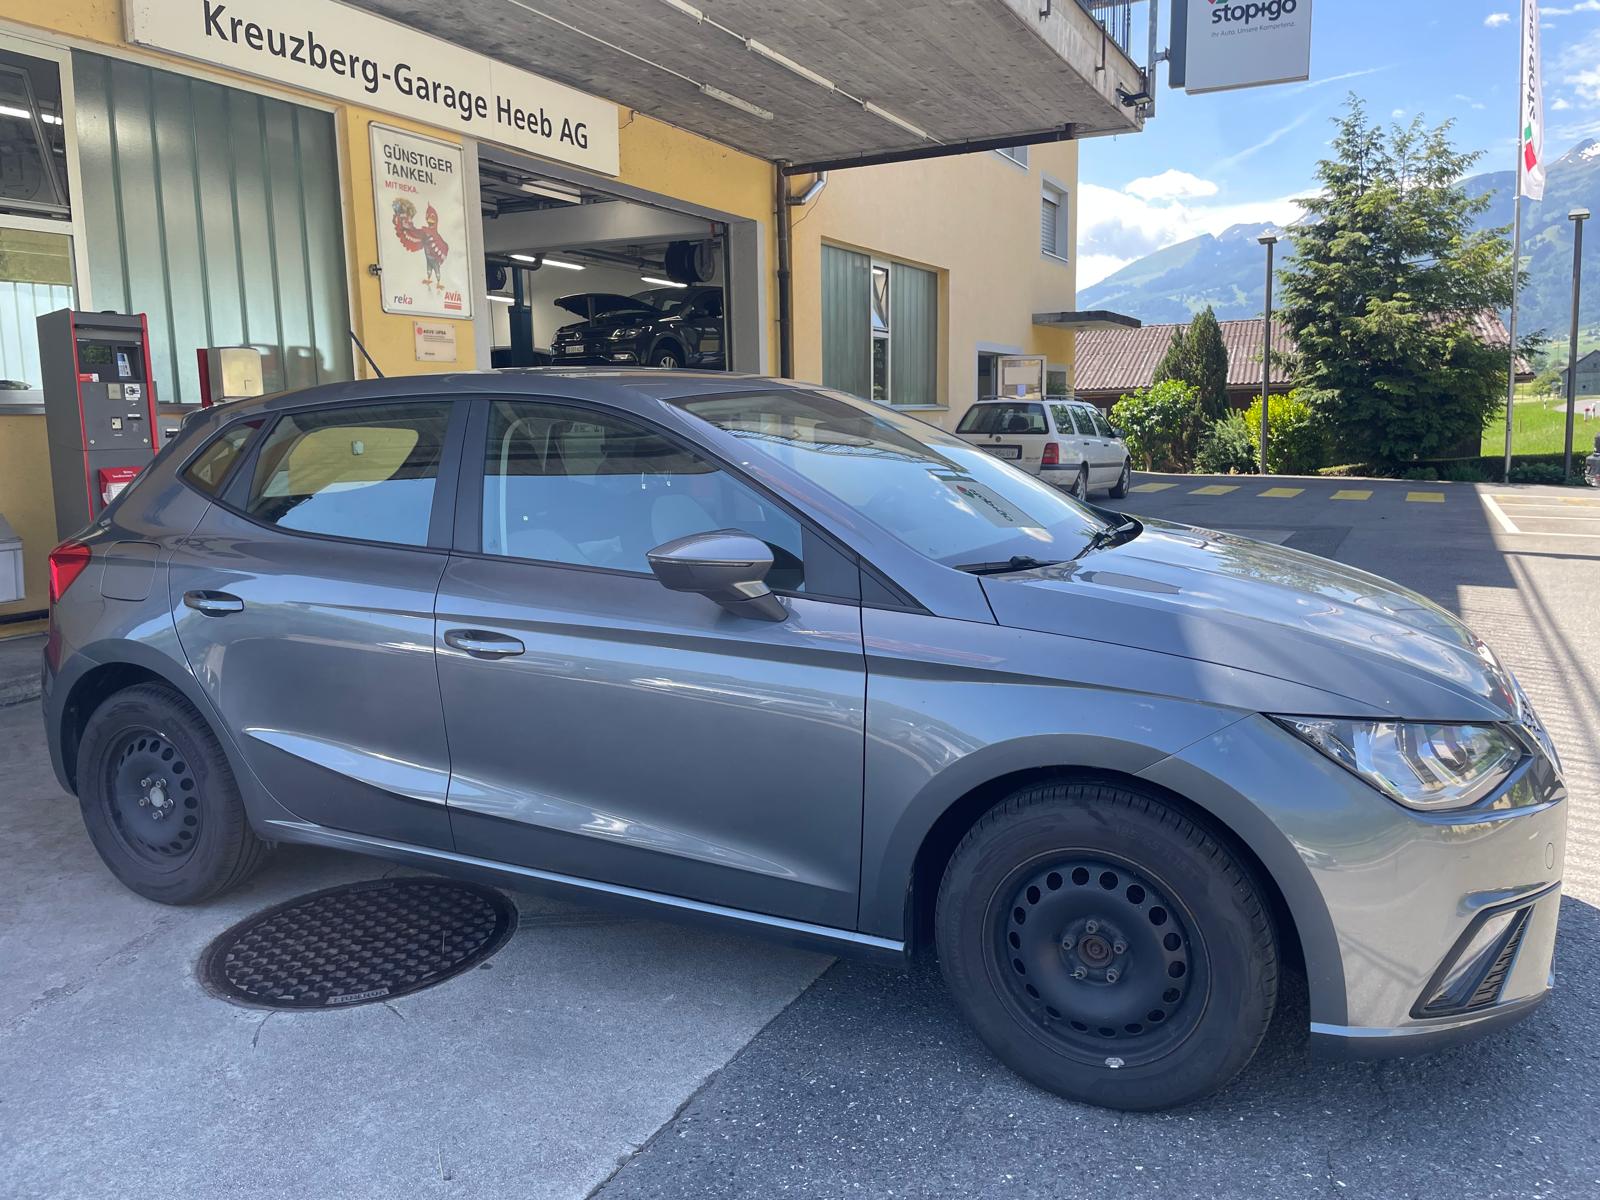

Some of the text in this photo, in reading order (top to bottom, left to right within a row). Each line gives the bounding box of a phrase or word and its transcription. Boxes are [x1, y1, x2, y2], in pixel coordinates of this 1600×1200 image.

[1212, 0, 1297, 24] stop+go
[203, 0, 589, 150] Kreuzberg-Garage Heeb AG
[384, 144, 452, 173] GÜNSTIGER
[384, 161, 437, 185] TANKEN.
[394, 294, 413, 305] reka
